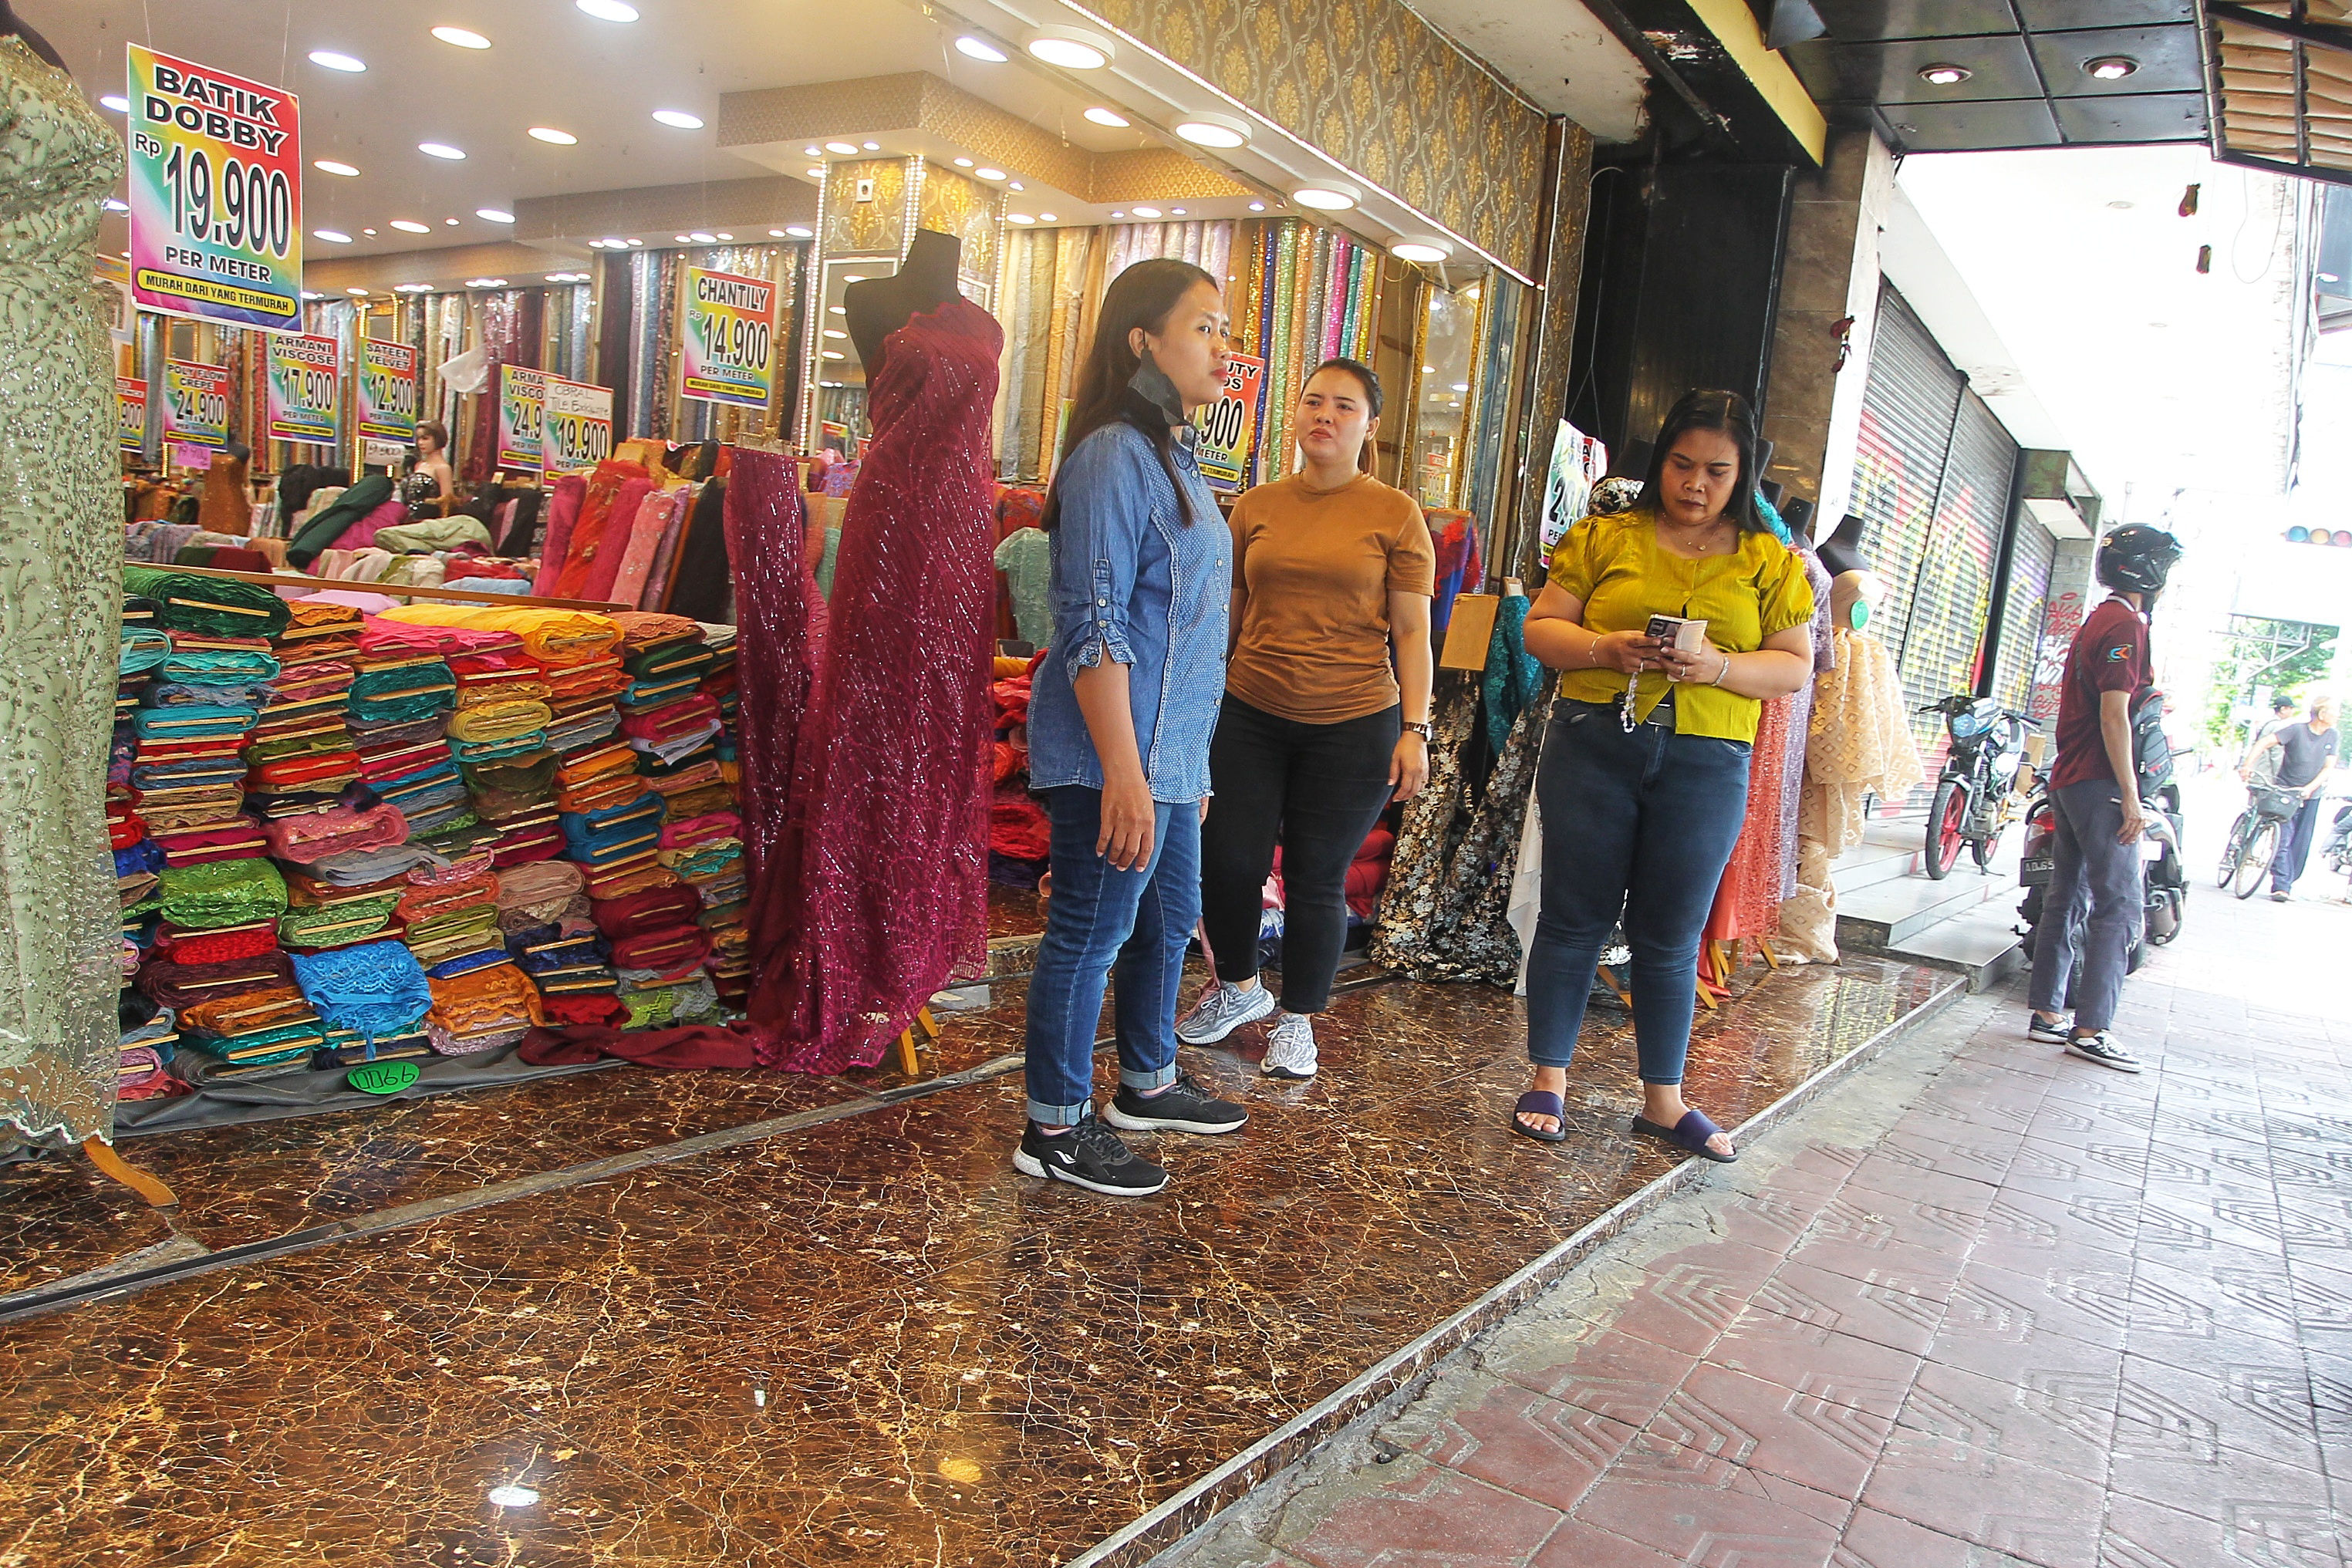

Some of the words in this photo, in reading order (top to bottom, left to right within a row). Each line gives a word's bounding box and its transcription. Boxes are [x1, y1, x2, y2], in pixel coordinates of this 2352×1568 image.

[155, 65, 280, 126] BATIK
[145, 94, 289, 156] DOBBY
[134, 132, 160, 157] Rp
[164, 144, 290, 259] 19.900
[166, 246, 204, 268] PER
[210, 255, 272, 283] METER
[146, 275, 184, 292] MURAH
[186, 282, 209, 296] DARI
[211, 287, 236, 301] YANG
[238, 292, 289, 312] TERMURAH
[698, 278, 769, 312] CHANTILY
[689, 309, 702, 320] Rp
[272, 347, 336, 366] VISCOSE
[275, 336, 333, 353] ARMANI
[366, 342, 410, 359] SATEEN
[703, 314, 769, 371] 14.900
[167, 364, 193, 376] POLY
[197, 369, 225, 382] FLOW
[366, 354, 410, 371] VELVET
[511, 370, 544, 386] ARMA
[700, 365, 719, 376] PER
[723, 369, 754, 382] METER
[1227, 360, 1260, 380] UTY
[180, 377, 214, 391] CREPE
[282, 367, 334, 412] 17.900
[370, 373, 414, 416] 12.900
[509, 383, 544, 400] VISCO
[120, 401, 143, 430] 900
[175, 389, 225, 426] 24.900
[512, 401, 542, 440] 24.9
[558, 416, 608, 462] 19.900
[1201, 396, 1245, 451] 900
